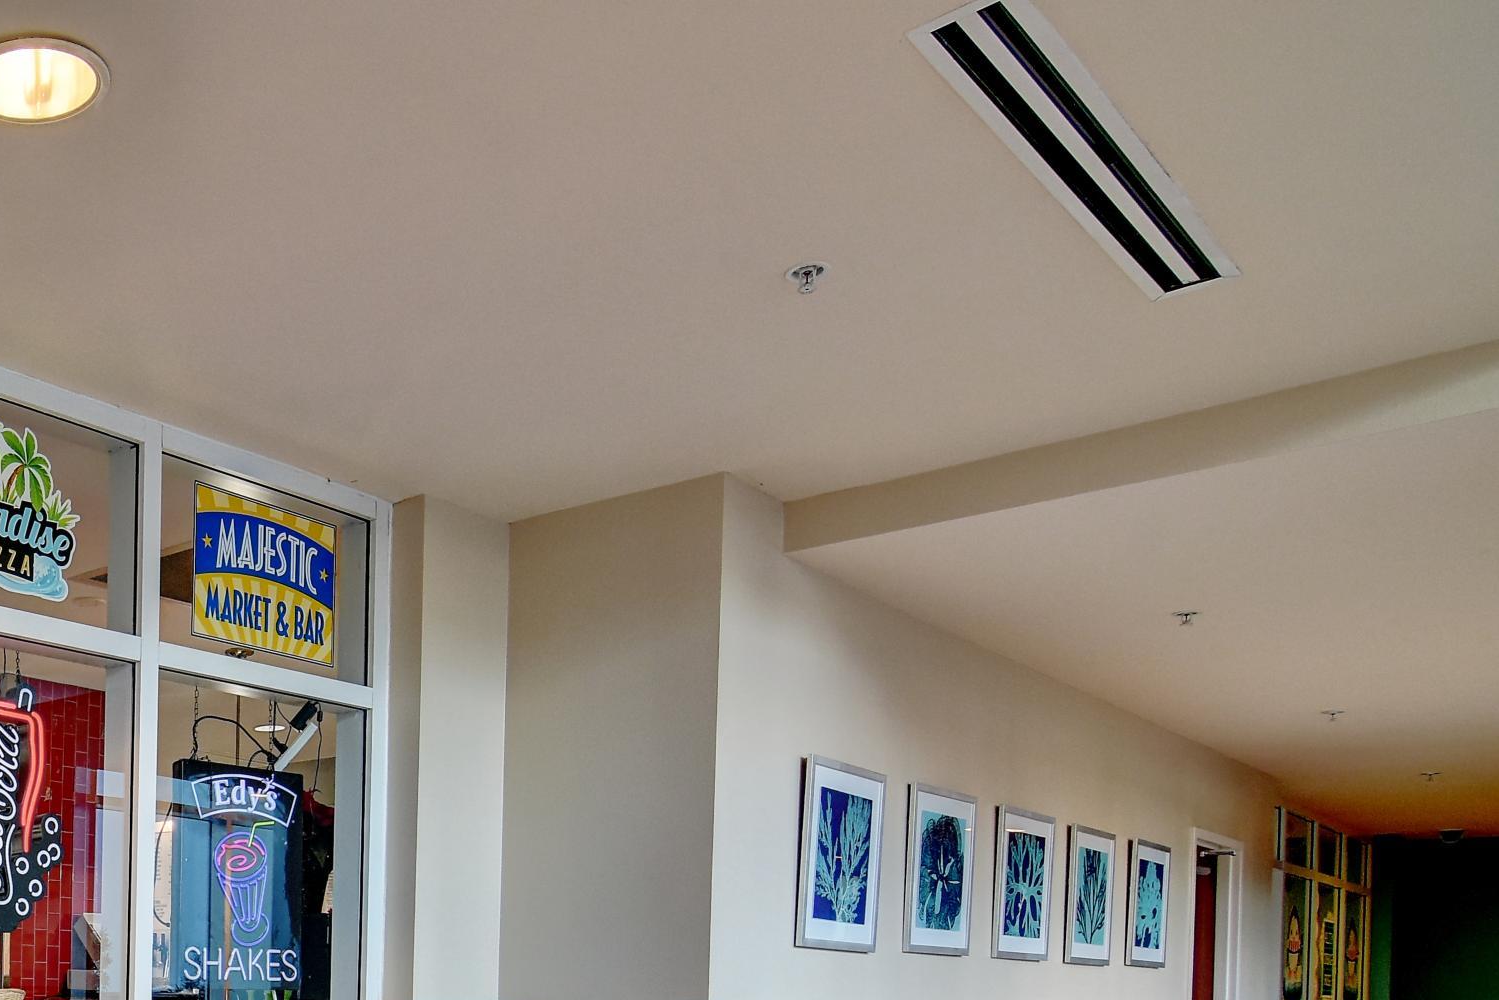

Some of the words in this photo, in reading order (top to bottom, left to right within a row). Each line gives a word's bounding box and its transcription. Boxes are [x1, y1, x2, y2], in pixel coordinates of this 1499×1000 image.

[216, 517, 317, 595] MAJESTIC
[204, 582, 271, 632] MARKET
[276, 606, 290, 639] &
[294, 606, 324, 647] BAR
[212, 777, 277, 812] Edy's
[184, 946, 297, 982] SHAKES
